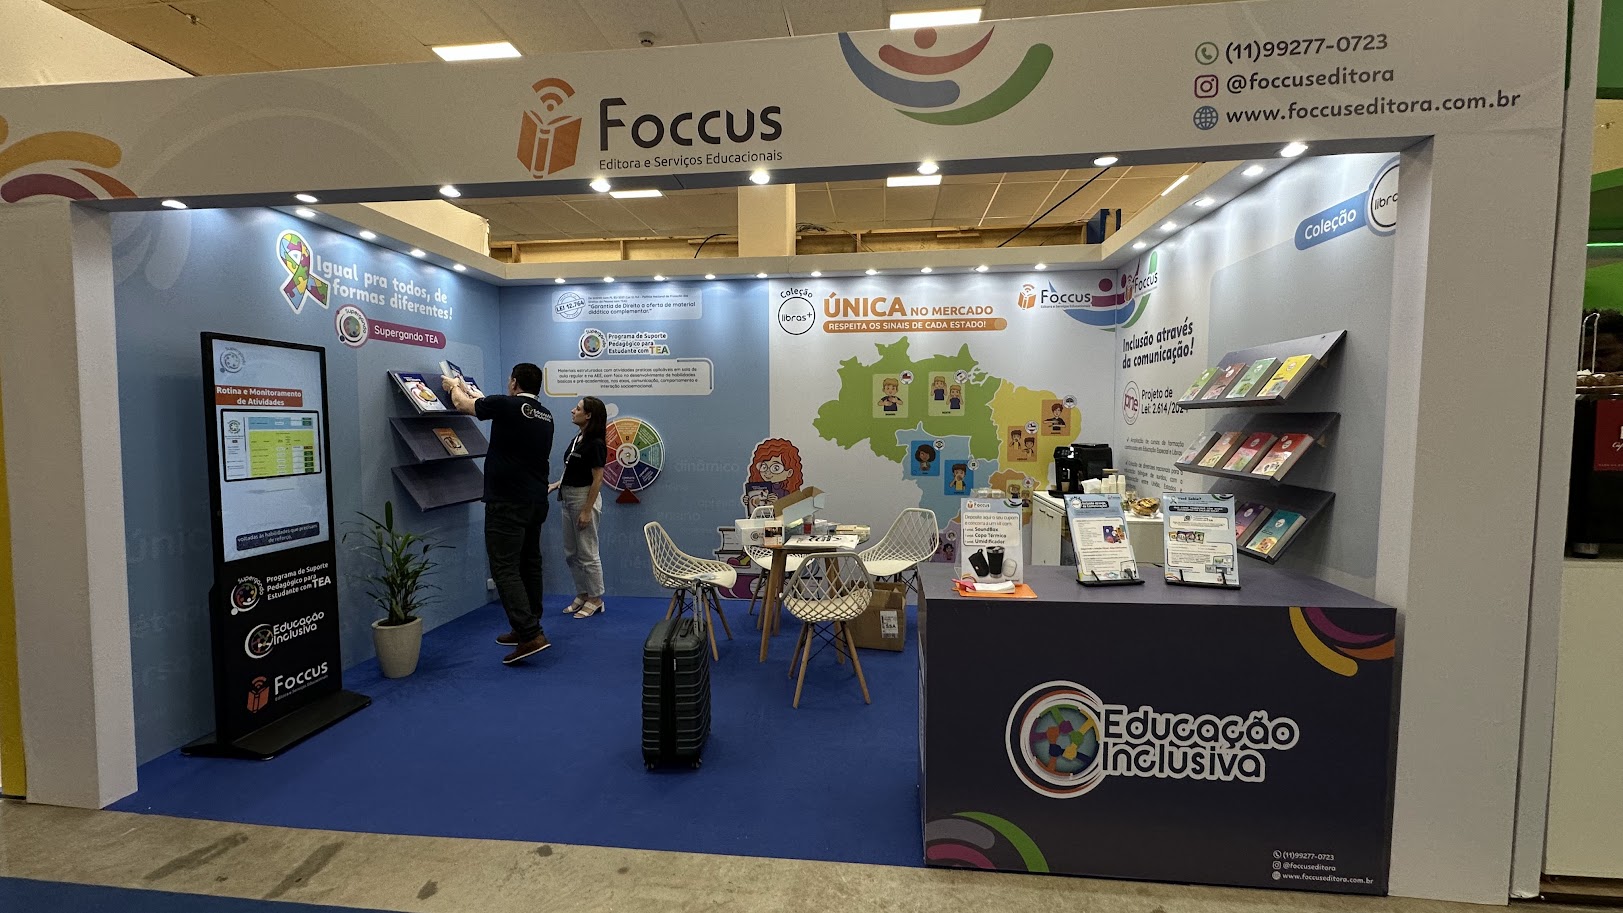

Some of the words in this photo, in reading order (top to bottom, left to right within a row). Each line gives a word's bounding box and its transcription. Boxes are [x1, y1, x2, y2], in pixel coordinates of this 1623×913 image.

[1226, 34, 1388, 64] (11)99277-0723
[1226, 67, 1394, 94] @foccuseditora
[1226, 90, 1521, 124] www.foccuseditora.com.br
[600, 97, 782, 152] Foccus
[600, 159, 641, 170] Editora
[644, 160, 651, 168] e
[654, 155, 702, 168] Serviços
[706, 150, 783, 164] Educacionais
[1304, 208, 1356, 240] Coleção
[316, 254, 358, 282] Igual
[364, 272, 388, 288] pra
[392, 278, 430, 302] todos,
[434, 288, 448, 304] de
[1134, 272, 1158, 293] Foccus
[333, 278, 386, 306] formas
[390, 292, 452, 320] diferentes!
[780, 288, 813, 299] Coleção
[1041, 290, 1091, 304] Foccus
[824, 292, 907, 318] ÚNICA
[910, 307, 928, 316] NO
[932, 306, 993, 316] MERCADO
[374, 325, 424, 342] Supergando
[424, 334, 439, 344] TEA
[828, 322, 867, 330] RESPEITA
[869, 321, 880, 330] OS
[883, 321, 910, 329] SINAIS
[1123, 331, 1154, 352] Inclusão
[1157, 316, 1193, 342] através
[649, 346, 668, 354] TEA
[1123, 354, 1131, 369] da
[1134, 337, 1194, 367] comunicação!
[249, 388, 302, 397] Monitoramento
[1142, 388, 1163, 402] Projeto
[1164, 386, 1173, 398] de
[1142, 403, 1151, 414] Lei:
[266, 571, 296, 583] Programa
[306, 562, 328, 573] Suporte
[267, 578, 302, 592] Pedagógico
[304, 574, 317, 583] para
[267, 586, 299, 600] Estudante
[312, 576, 331, 588] TEA
[273, 611, 324, 635] Educação
[273, 623, 318, 645] Inclusiva
[274, 662, 328, 695] Foccus
[1103, 709, 1296, 749] Educação
[1102, 741, 1262, 778] Inclusiva
[1282, 851, 1334, 860] (11)99277-0723
[1283, 862, 1336, 871] @foccuseditora
[1282, 873, 1373, 884] www.foccuseditora.com.br
